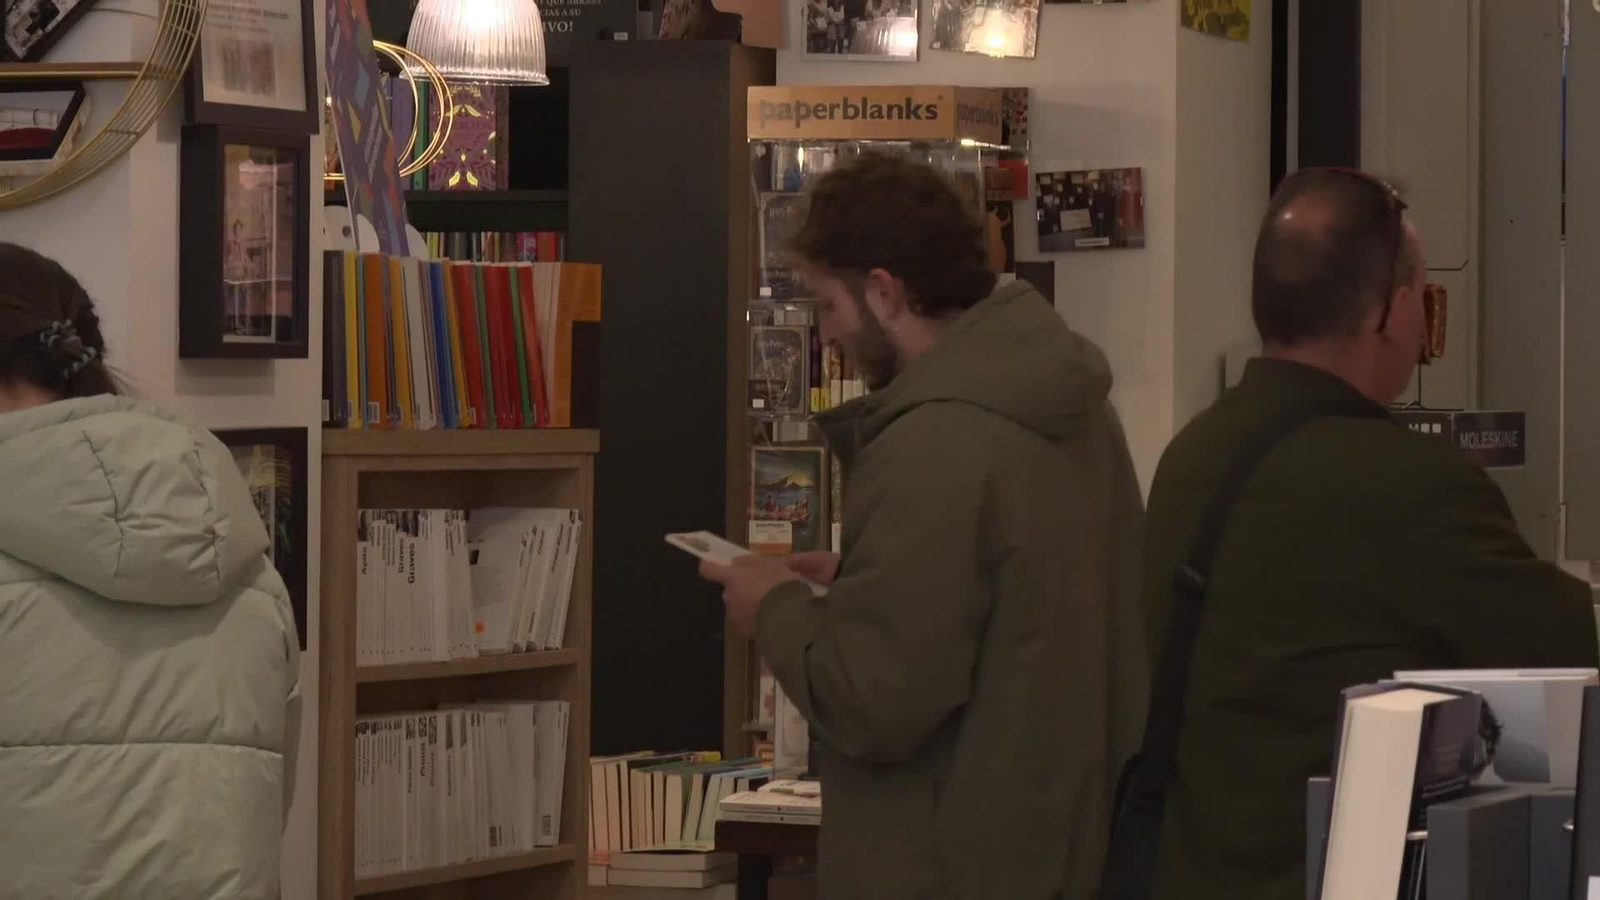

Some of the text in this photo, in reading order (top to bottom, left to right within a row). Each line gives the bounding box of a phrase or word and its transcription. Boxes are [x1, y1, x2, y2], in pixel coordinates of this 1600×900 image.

[542, 21, 573, 33] IVO!
[758, 96, 939, 129] paperblanks
[1459, 429, 1519, 450] MOLESKINE
[407, 542, 415, 584] Graves
